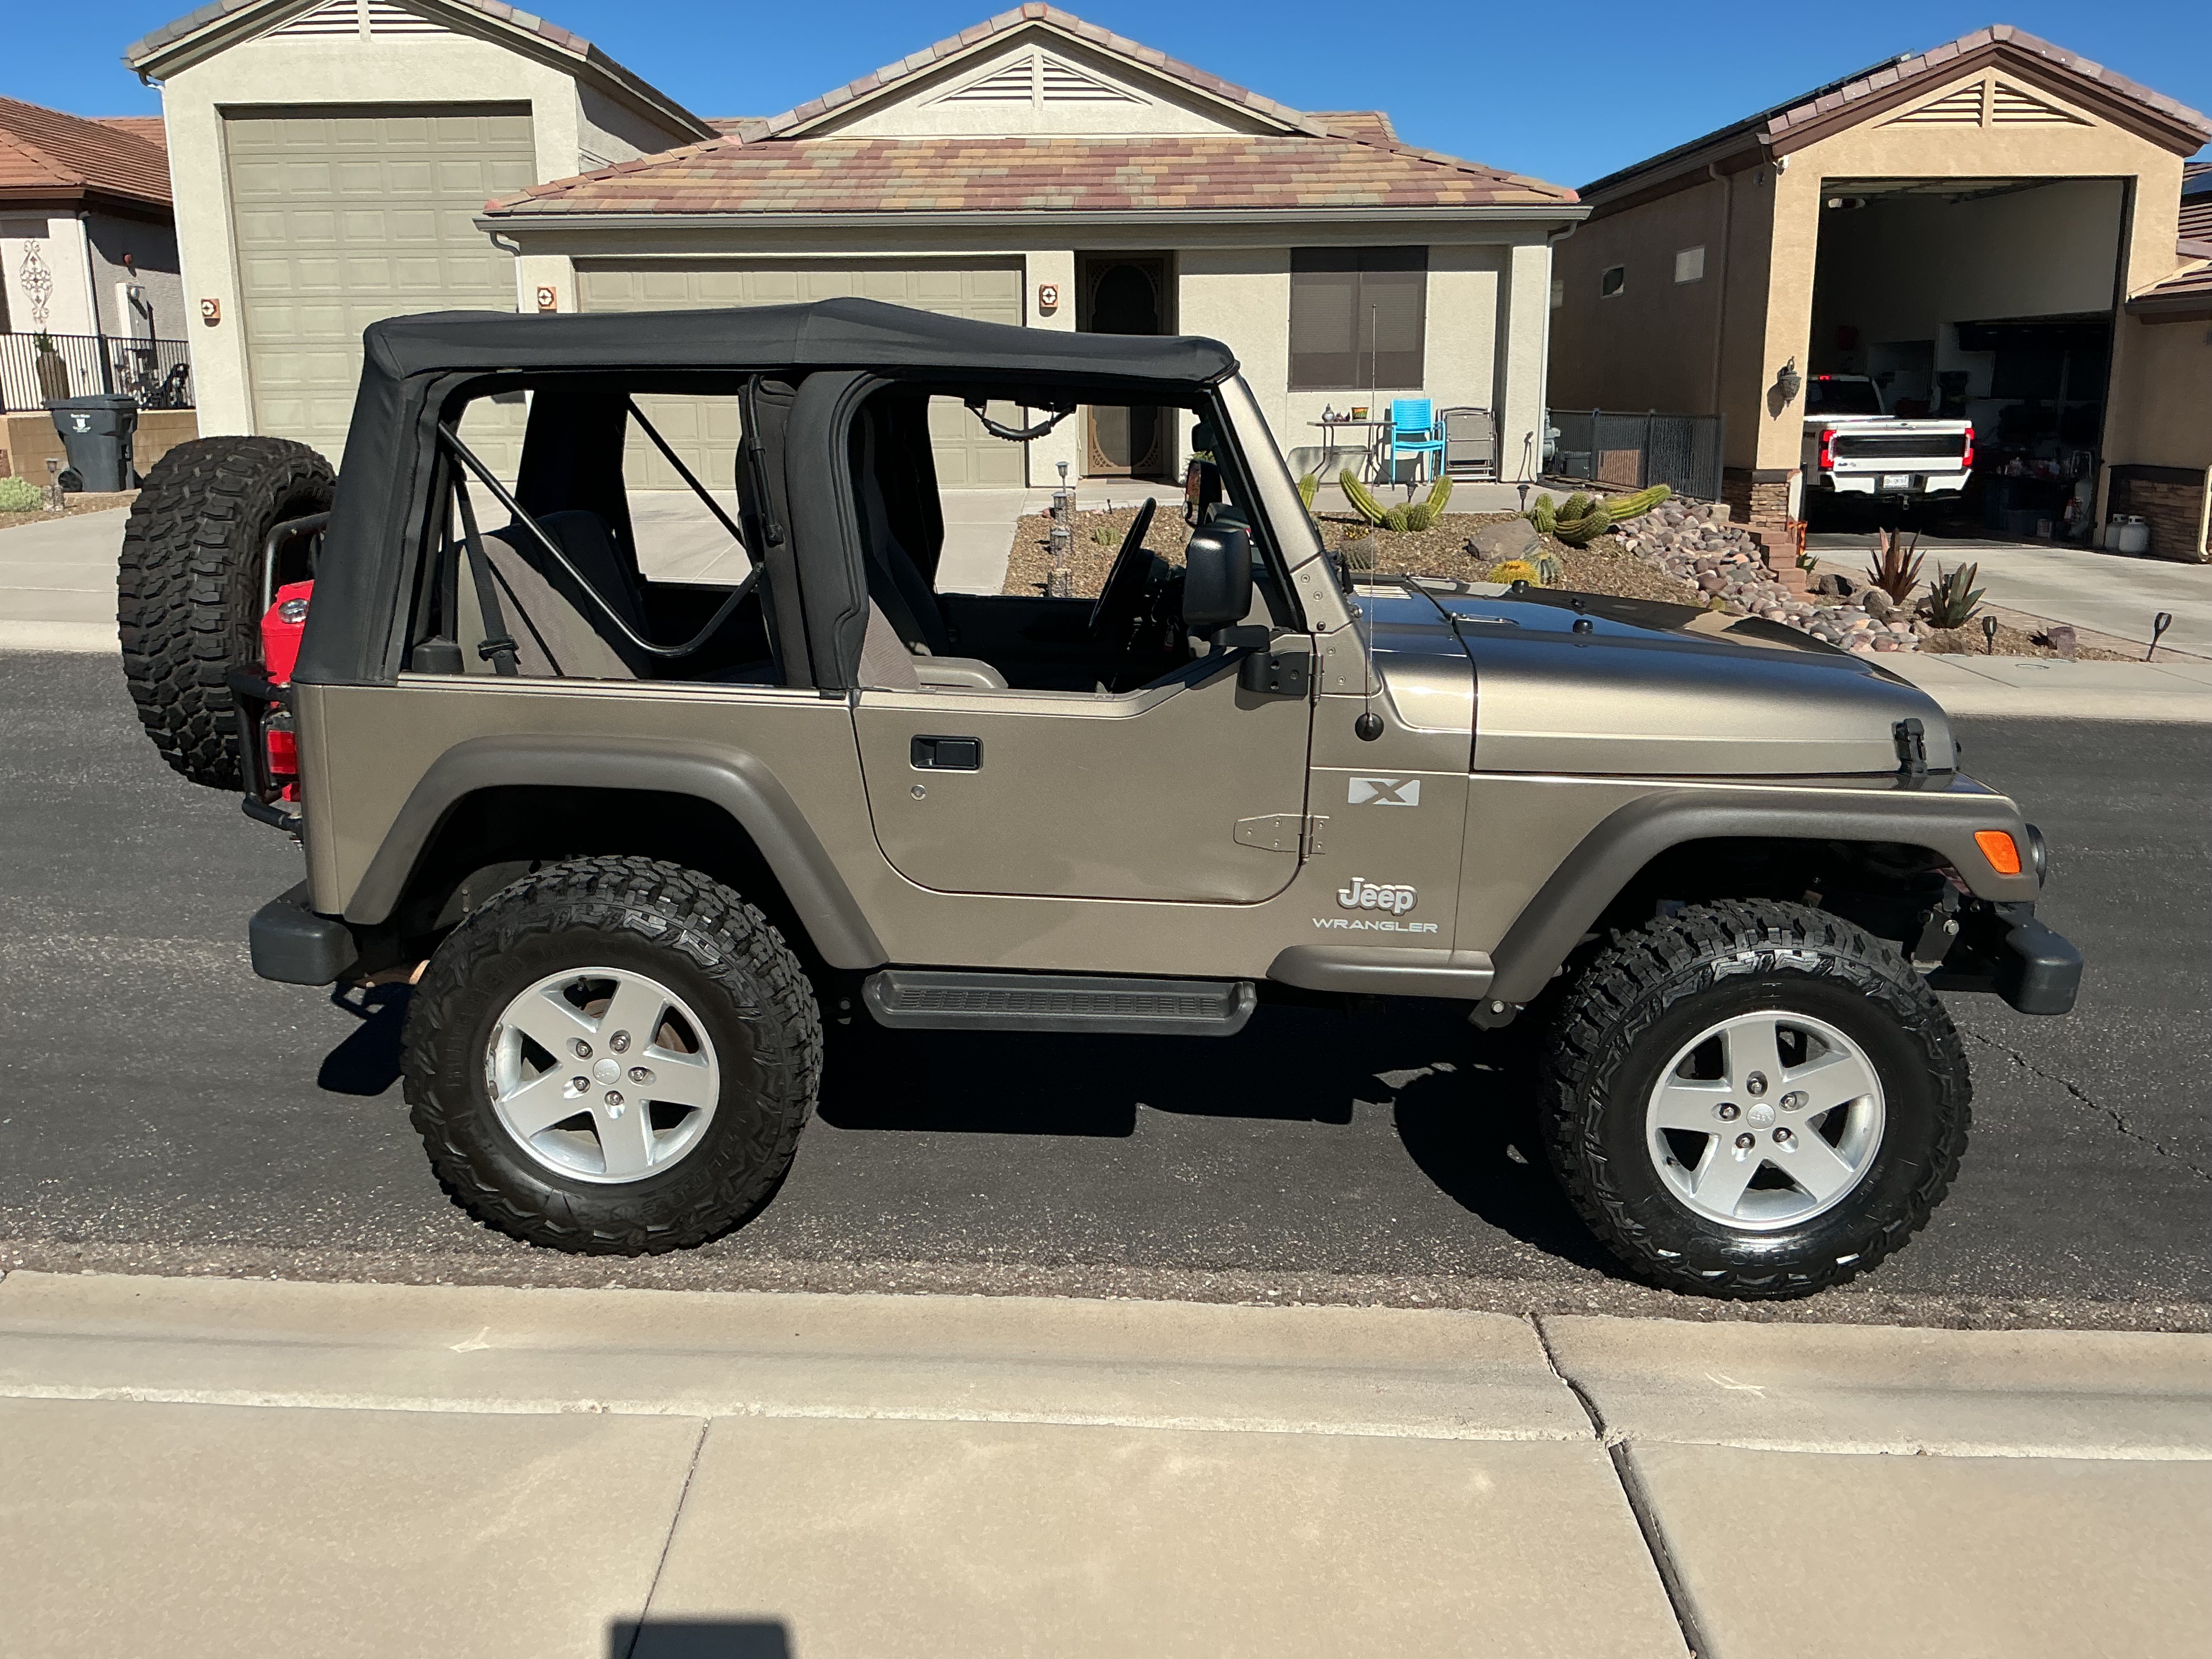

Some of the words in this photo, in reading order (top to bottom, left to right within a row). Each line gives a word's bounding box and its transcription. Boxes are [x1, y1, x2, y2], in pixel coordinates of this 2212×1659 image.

[1357, 778, 1417, 806] X
[1339, 880, 1415, 915] Jeep
[1312, 918, 1438, 933] WRANGLER
